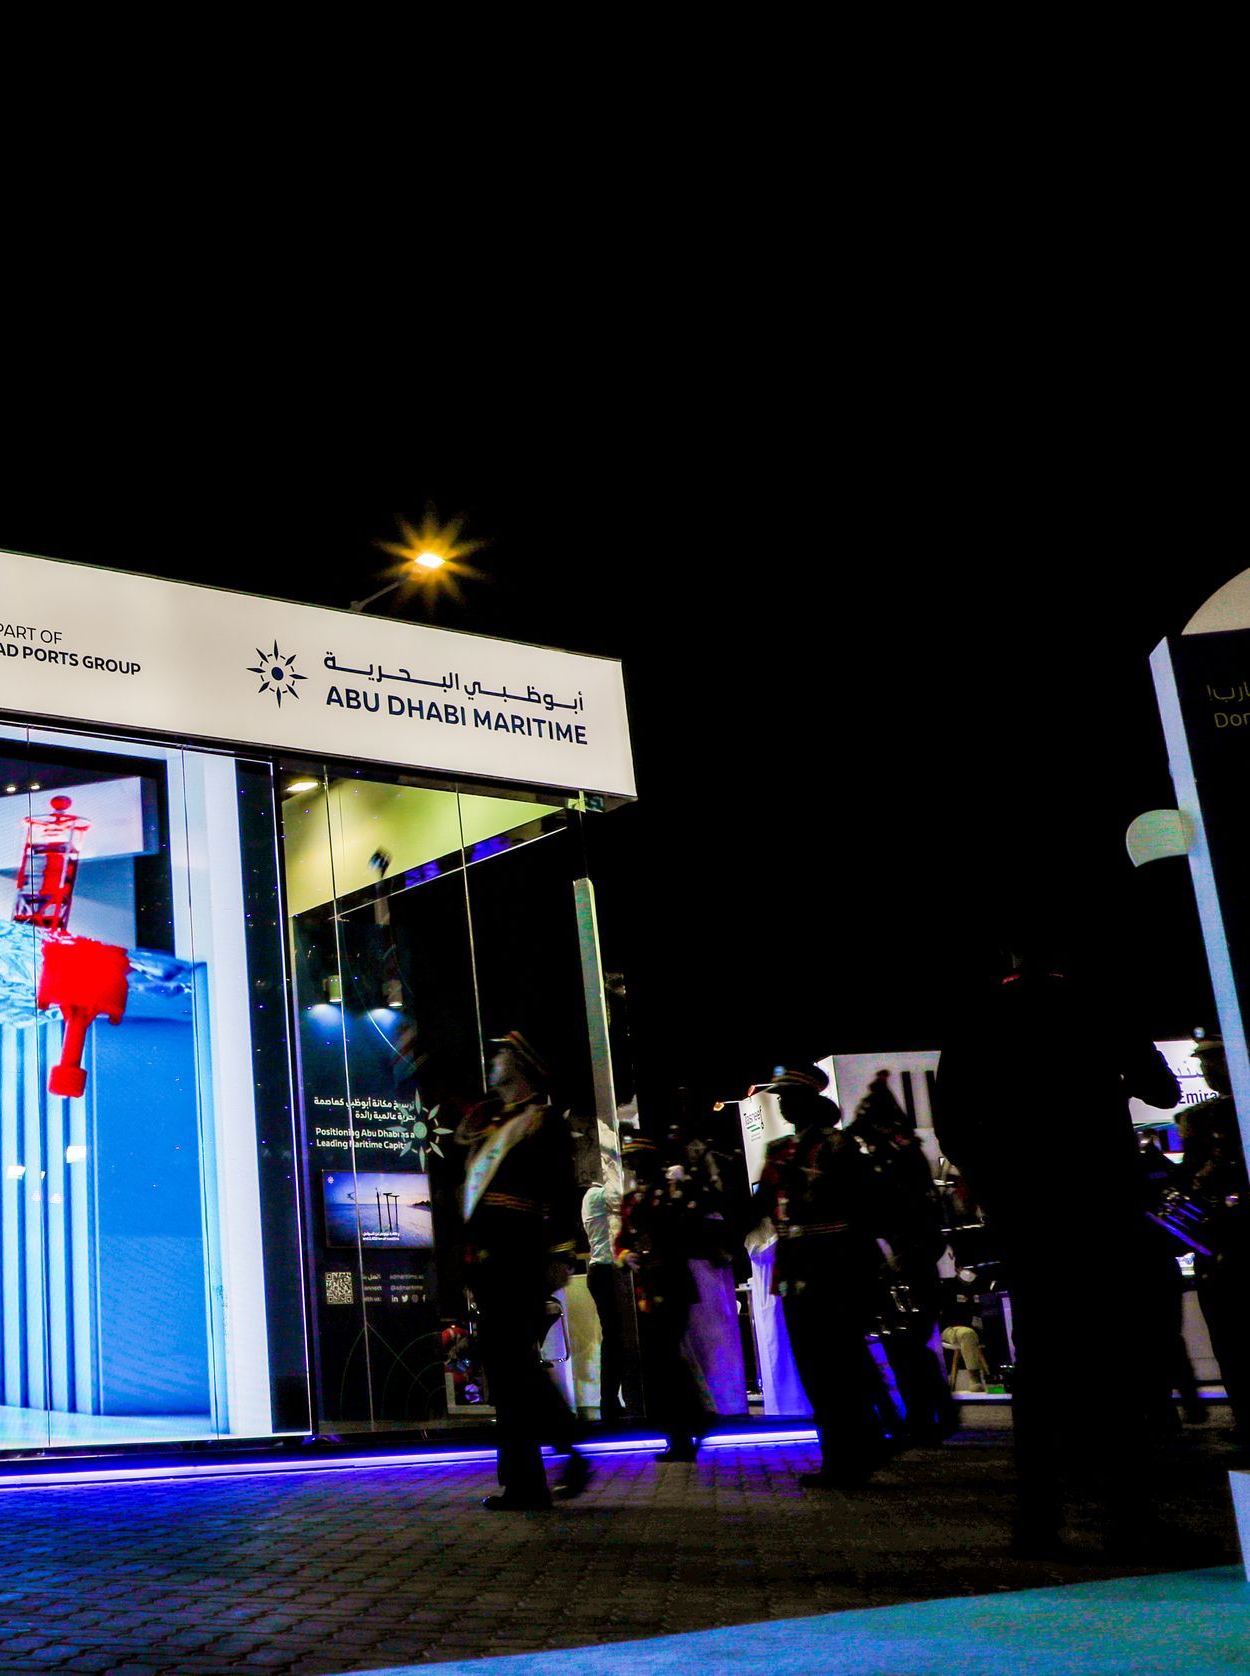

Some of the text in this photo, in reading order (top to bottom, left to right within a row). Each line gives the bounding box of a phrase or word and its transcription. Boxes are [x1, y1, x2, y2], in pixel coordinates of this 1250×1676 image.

[40, 630, 62, 644] OF
[22, 646, 78, 666] PORTS
[82, 655, 141, 675] GROUP
[324, 651, 584, 715] أبوظبي البحرية
[326, 686, 588, 745] ABU DHABI MARITIME
[1177, 1090, 1218, 1104] Emira
[361, 1129, 376, 1137] Abu
[316, 1139, 348, 1150] Leading
[383, 1141, 409, 1150] Capit
